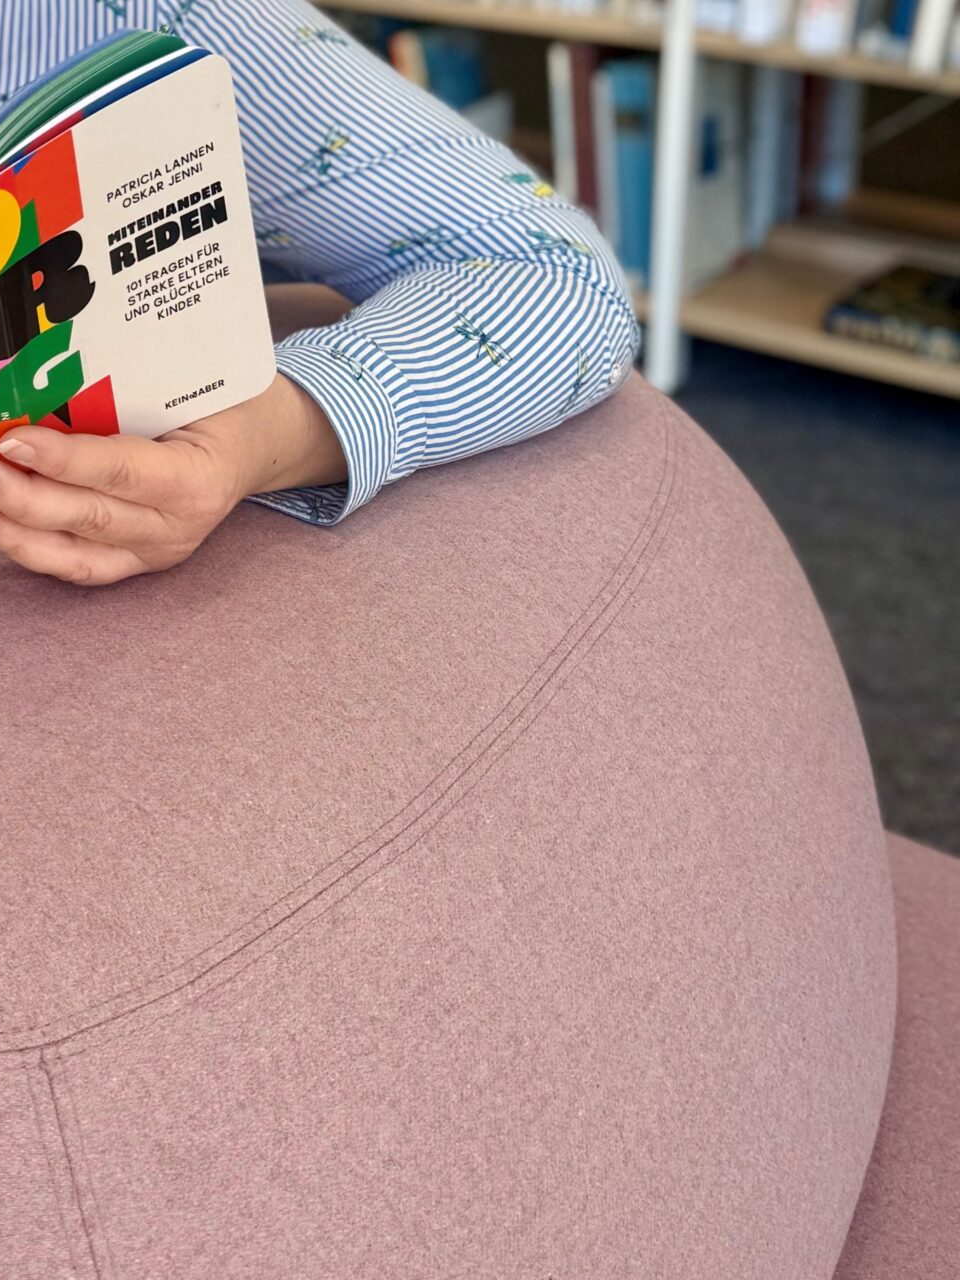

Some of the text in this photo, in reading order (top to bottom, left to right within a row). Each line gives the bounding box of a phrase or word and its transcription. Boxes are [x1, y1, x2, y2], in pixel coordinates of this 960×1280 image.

[106, 141, 214, 203] PATRICIA LANNEN
[122, 162, 203, 208] OSKAR JENNI
[107, 180, 228, 276] MITEINANDER REDEN
[124, 265, 231, 322] UND GLÜCKLICHE
[126, 242, 220, 293] 101 FRAGEN FÜR
[127, 254, 224, 307] STARKE ELTERN
[156, 293, 202, 321] KINDER
